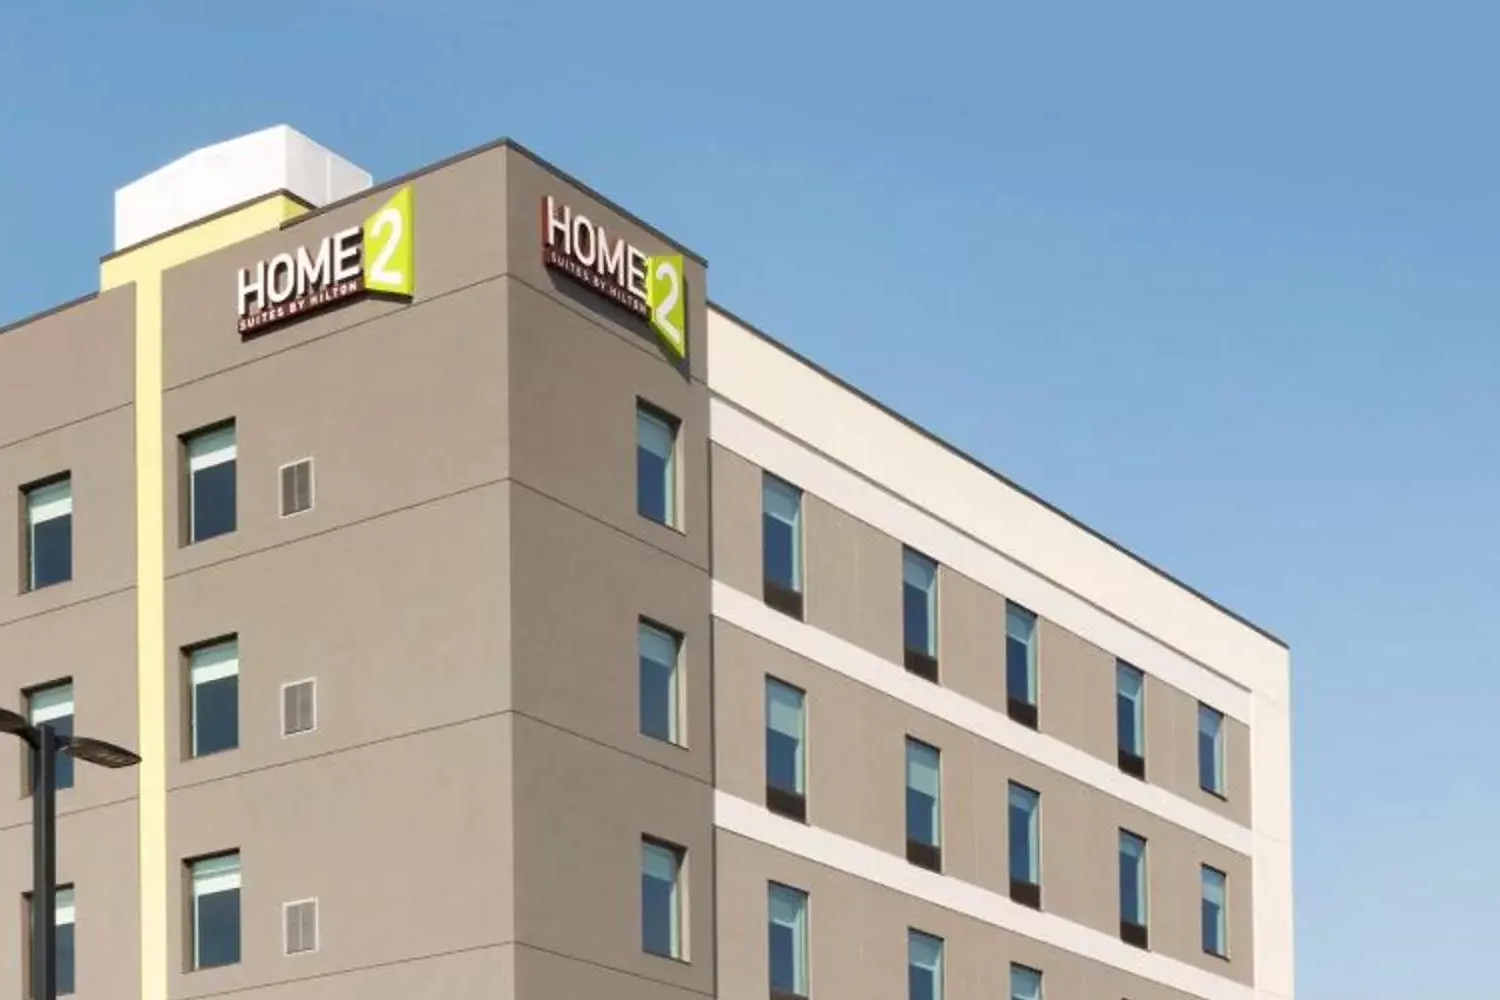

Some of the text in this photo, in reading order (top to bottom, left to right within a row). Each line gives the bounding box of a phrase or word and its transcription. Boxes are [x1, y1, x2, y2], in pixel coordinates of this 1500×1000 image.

[239, 280, 358, 331] SUITES BY HILTON
